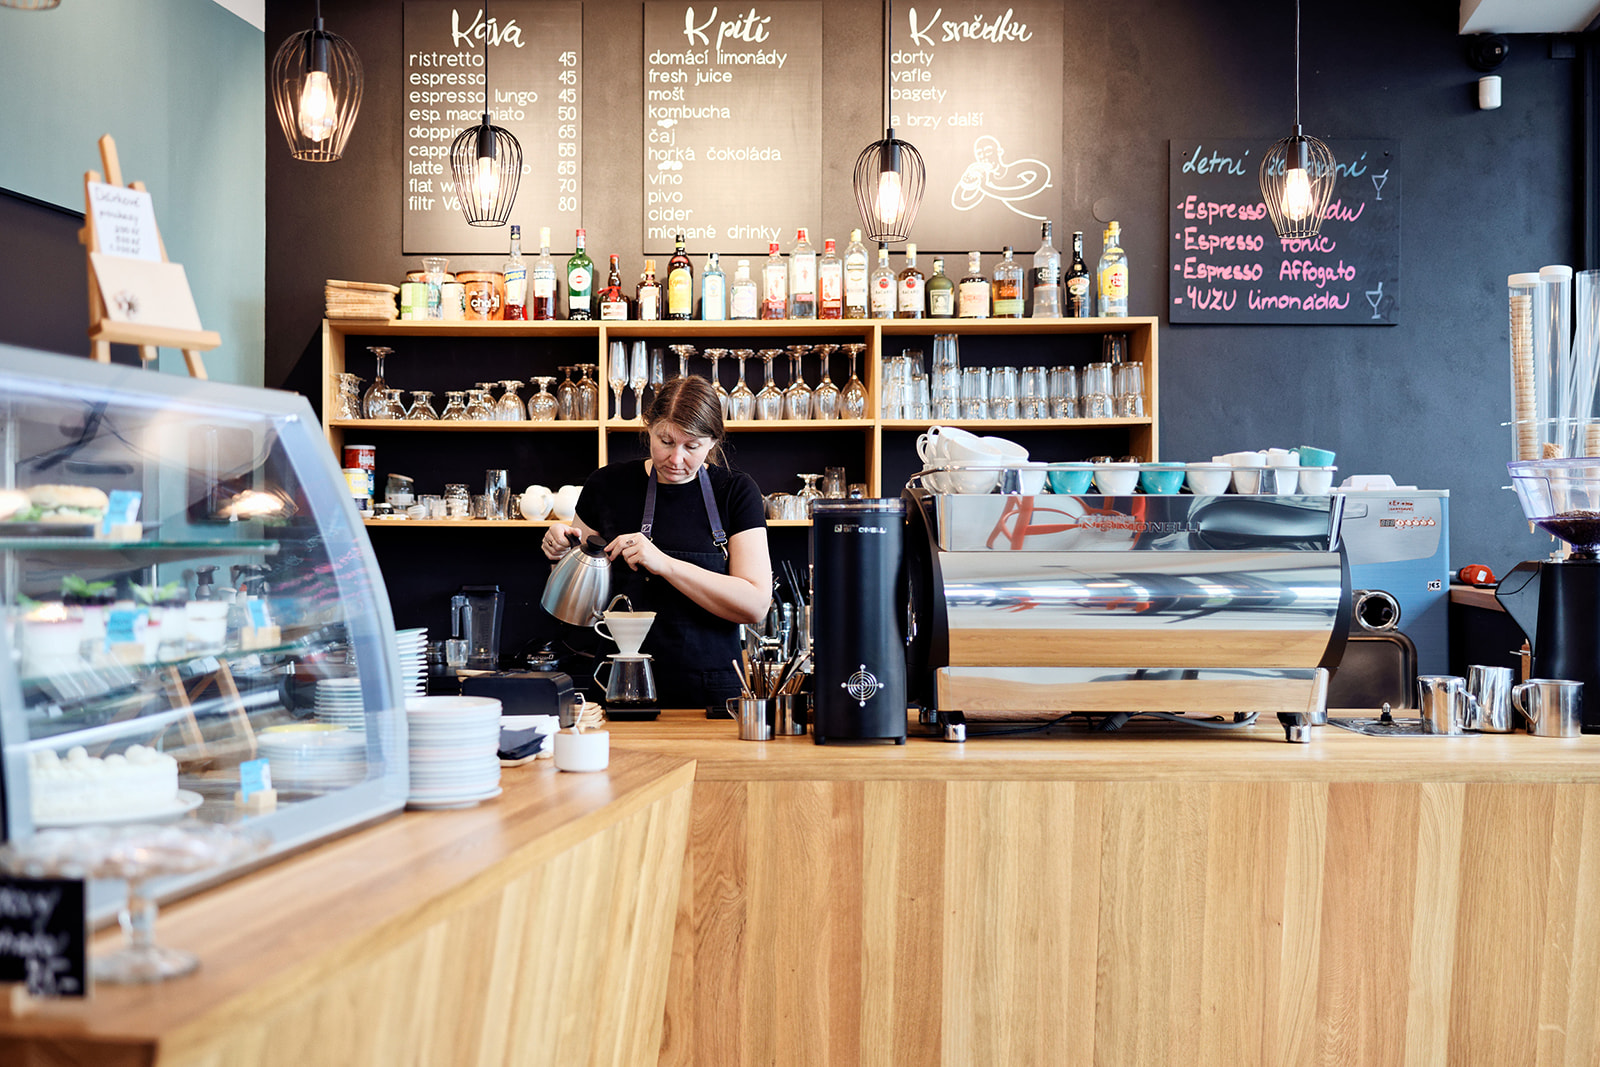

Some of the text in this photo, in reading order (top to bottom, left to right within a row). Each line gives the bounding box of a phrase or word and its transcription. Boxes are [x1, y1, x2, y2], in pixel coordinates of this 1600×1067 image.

[451, 9, 526, 48] Káva
[683, 6, 771, 51] K pití
[908, 7, 1033, 46] K snědku
[409, 51, 577, 67] ristretto 45
[649, 50, 788, 69] domácí limonády
[891, 50, 935, 67] dorty
[409, 70, 577, 87] espresso 45
[649, 69, 733, 86] fresh juice
[891, 68, 932, 82] vafle
[409, 88, 577, 107] espresso lungo 45
[648, 87, 685, 101] mošt
[891, 86, 947, 104] bagety
[558, 106, 577, 121] 50
[649, 105, 731, 119] kombucha
[907, 112, 942, 130] brzy
[947, 112, 984, 127] další
[558, 124, 577, 139] 65
[649, 128, 676, 146] čaj
[648, 147, 782, 161] horká čokoláda
[409, 160, 444, 175] latte
[409, 178, 433, 192] flat
[558, 179, 577, 193] 70
[649, 171, 683, 185] víno
[408, 196, 436, 211] filtr
[558, 196, 577, 212] 80
[649, 189, 683, 206] pivo
[648, 207, 693, 221] cider
[1184, 195, 1267, 225] Espresso
[648, 225, 782, 243] míchané drinky
[1185, 227, 1264, 255] Espresso
[1183, 257, 1356, 288] Espresso Affogato
